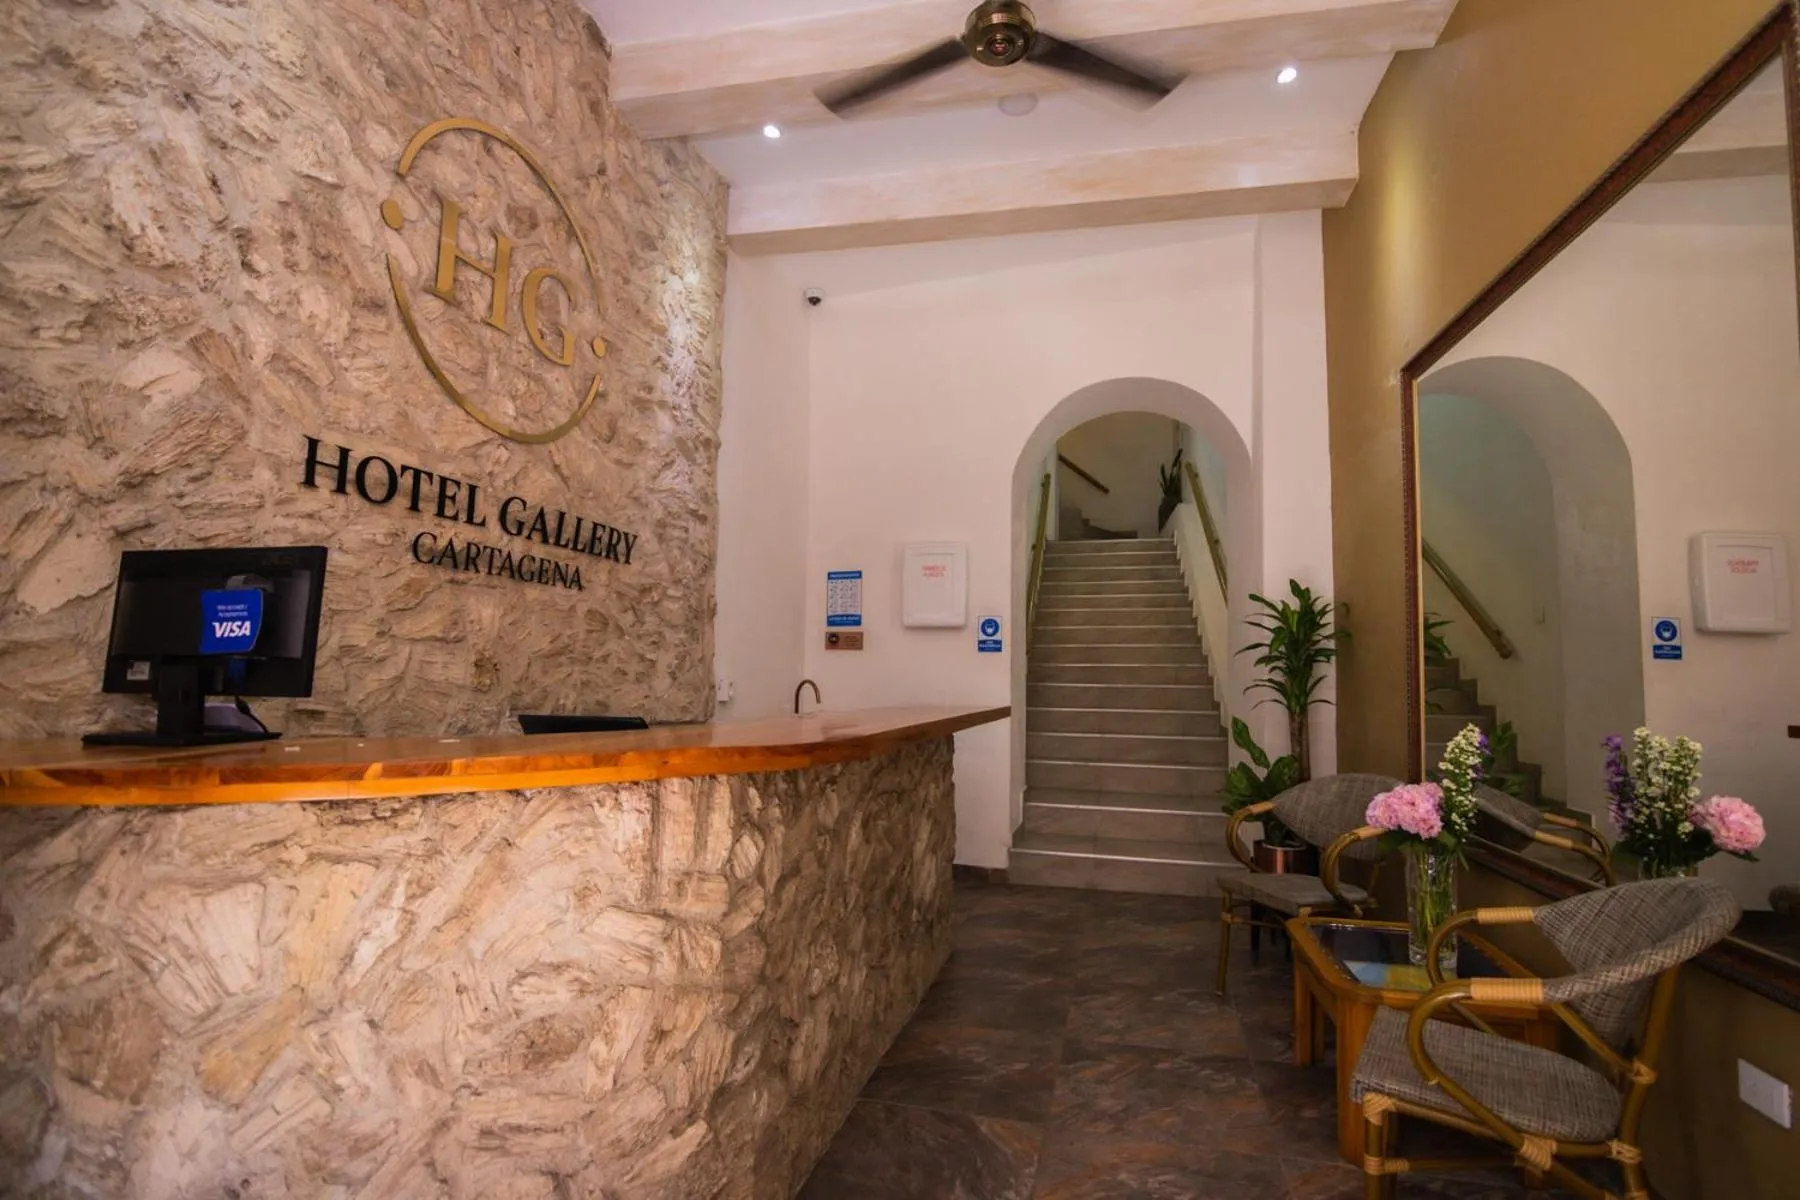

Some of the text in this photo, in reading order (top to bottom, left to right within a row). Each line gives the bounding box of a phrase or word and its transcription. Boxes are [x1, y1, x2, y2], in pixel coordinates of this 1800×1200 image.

[302, 434, 639, 566] HOTEL GALLERY
[412, 531, 585, 592] CARTAGENA
[212, 620, 251, 638] VISA
